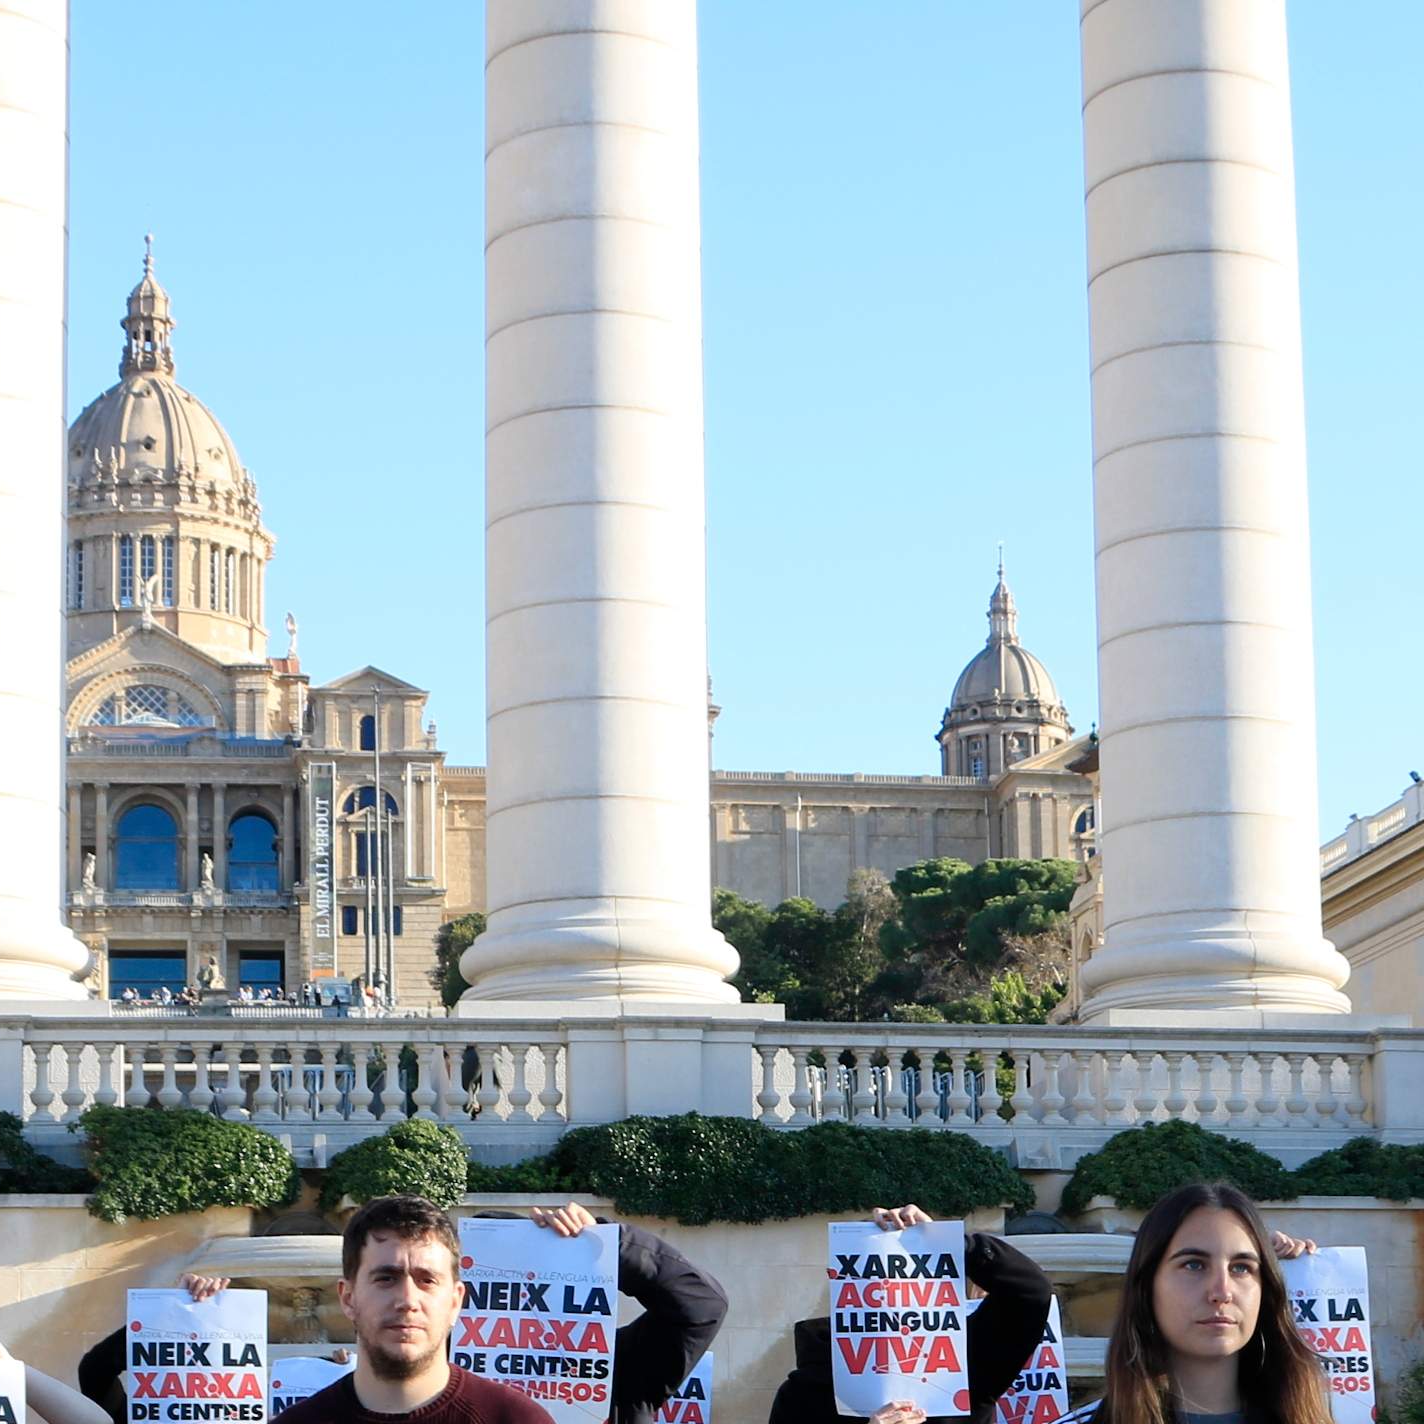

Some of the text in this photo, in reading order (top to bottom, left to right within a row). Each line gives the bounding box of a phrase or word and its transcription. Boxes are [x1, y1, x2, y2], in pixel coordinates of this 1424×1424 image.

[316, 797, 330, 856] PERDUT
[316, 858, 330, 917] MIRALL
[316, 919, 330, 938] EL
[537, 1272, 588, 1282] LLENGUA
[591, 1275, 614, 1283] VIVA
[834, 1253, 959, 1279] XARXA
[462, 1281, 611, 1315] NEIX LA
[836, 1281, 960, 1308] ACTIVA
[835, 1311, 961, 1333] LLENGUA
[1328, 1298, 1365, 1322] LA
[456, 1316, 609, 1353] XARXA
[132, 1342, 262, 1367] NEIX LA
[454, 1352, 609, 1379] DE CENTRES
[836, 1336, 961, 1374] VIVA
[133, 1372, 262, 1398] XARXA
[132, 1404, 263, 1420] DE CENTRES
